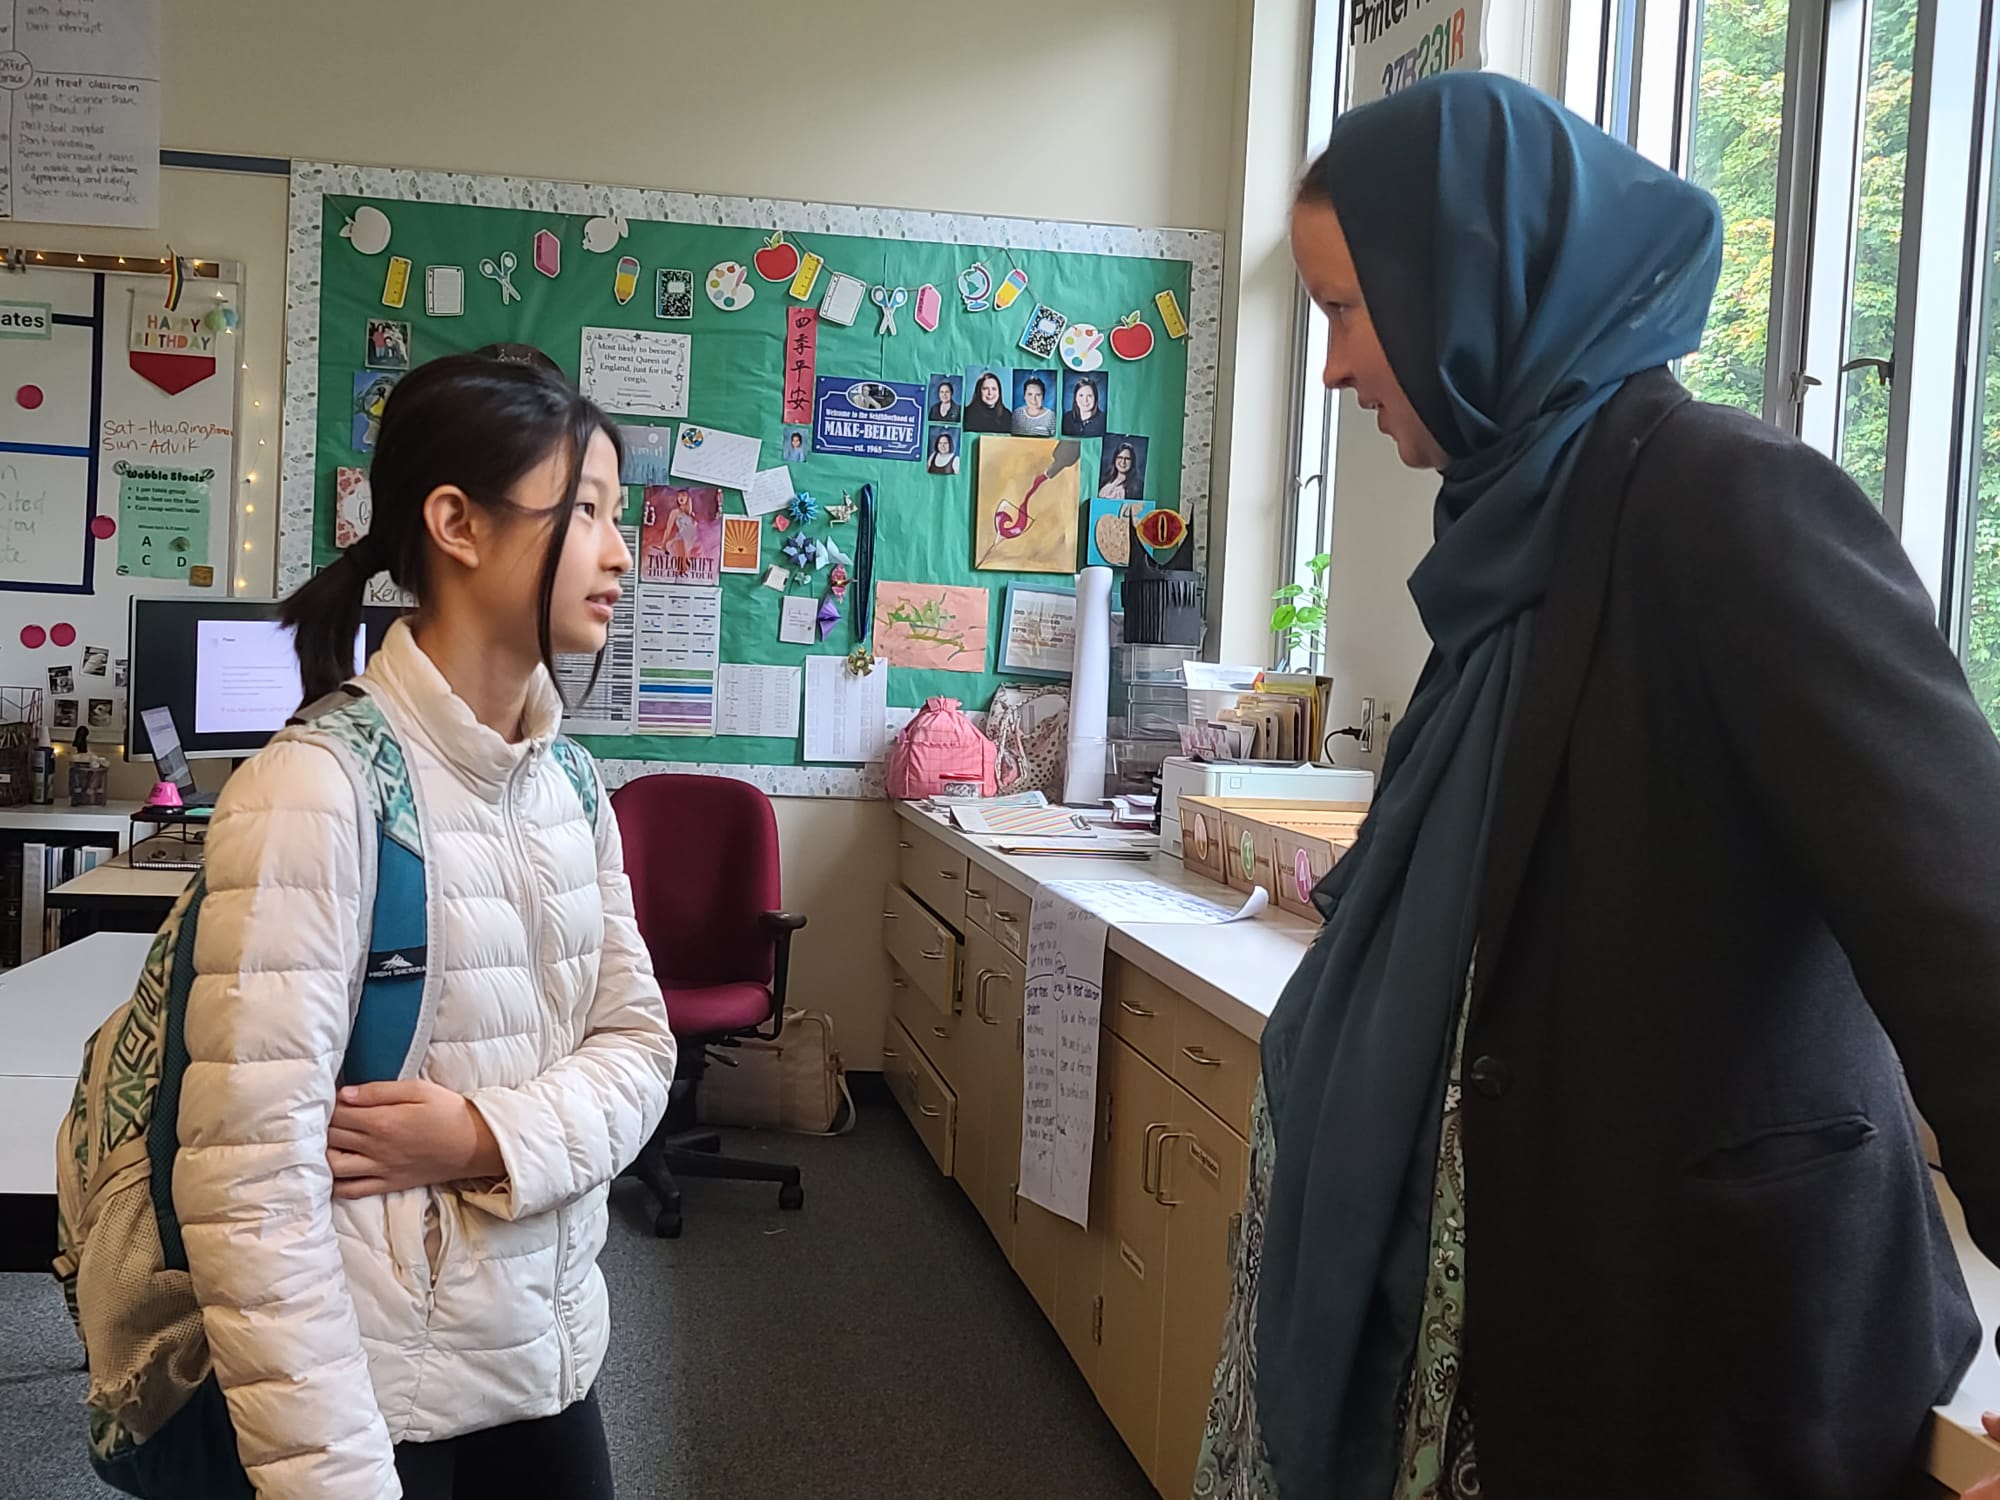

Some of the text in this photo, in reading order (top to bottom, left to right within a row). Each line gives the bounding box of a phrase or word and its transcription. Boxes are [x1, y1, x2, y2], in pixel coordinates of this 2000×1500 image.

[147, 314, 200, 332] HAPPY
[135, 331, 210, 351] BIRTHDAY
[598, 342, 616, 351] Most
[618, 343, 637, 354] likely
[649, 346, 677, 355] become
[604, 353, 616, 361] the
[635, 355, 660, 364] Queen
[648, 366, 660, 374] for
[660, 367, 673, 375] the
[824, 420, 914, 443] MAKE-BELIEVE
[127, 469, 169, 480] Wobble
[142, 536, 152, 547] A
[142, 555, 187, 567] C D
